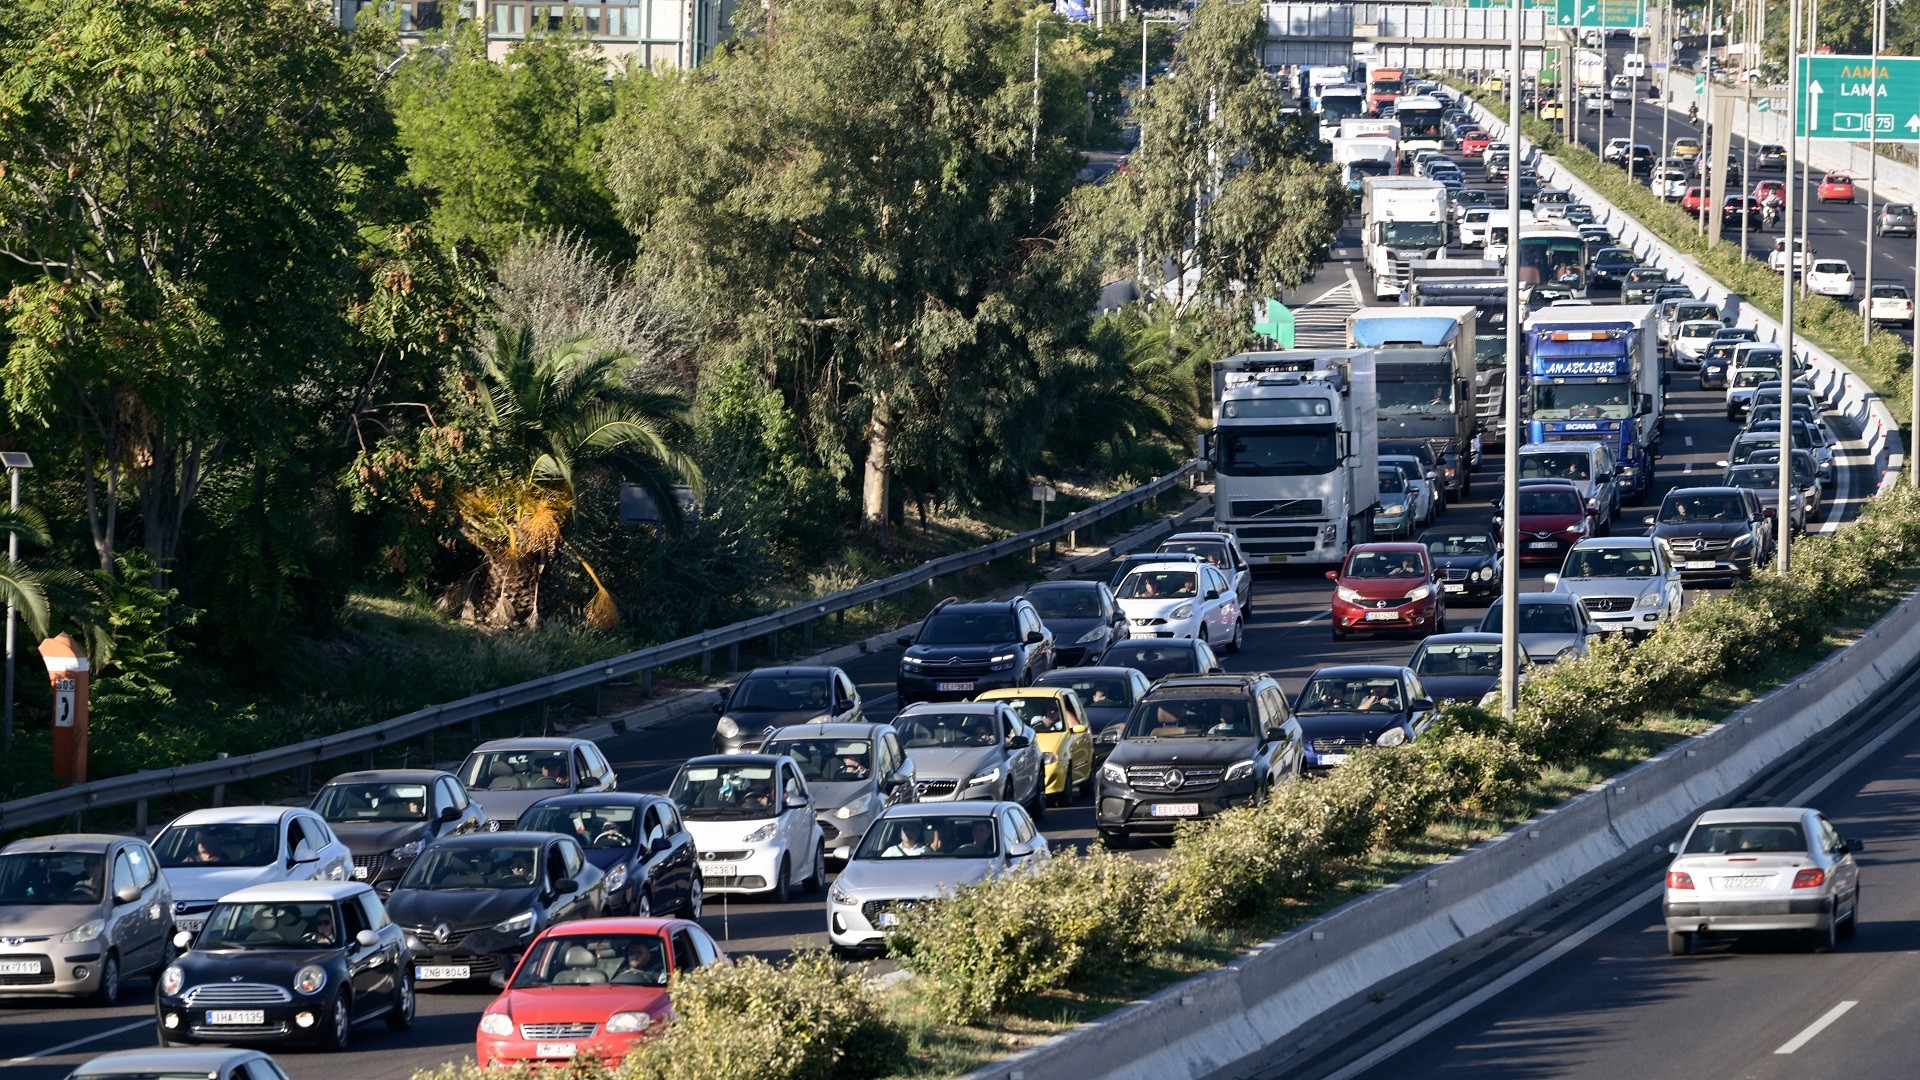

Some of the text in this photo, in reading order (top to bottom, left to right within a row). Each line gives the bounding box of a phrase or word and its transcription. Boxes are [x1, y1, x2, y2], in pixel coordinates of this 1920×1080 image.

[1840, 83, 1888, 97] LAMA
[1845, 116, 1851, 128] 1
[57, 679, 75, 690] SOS
